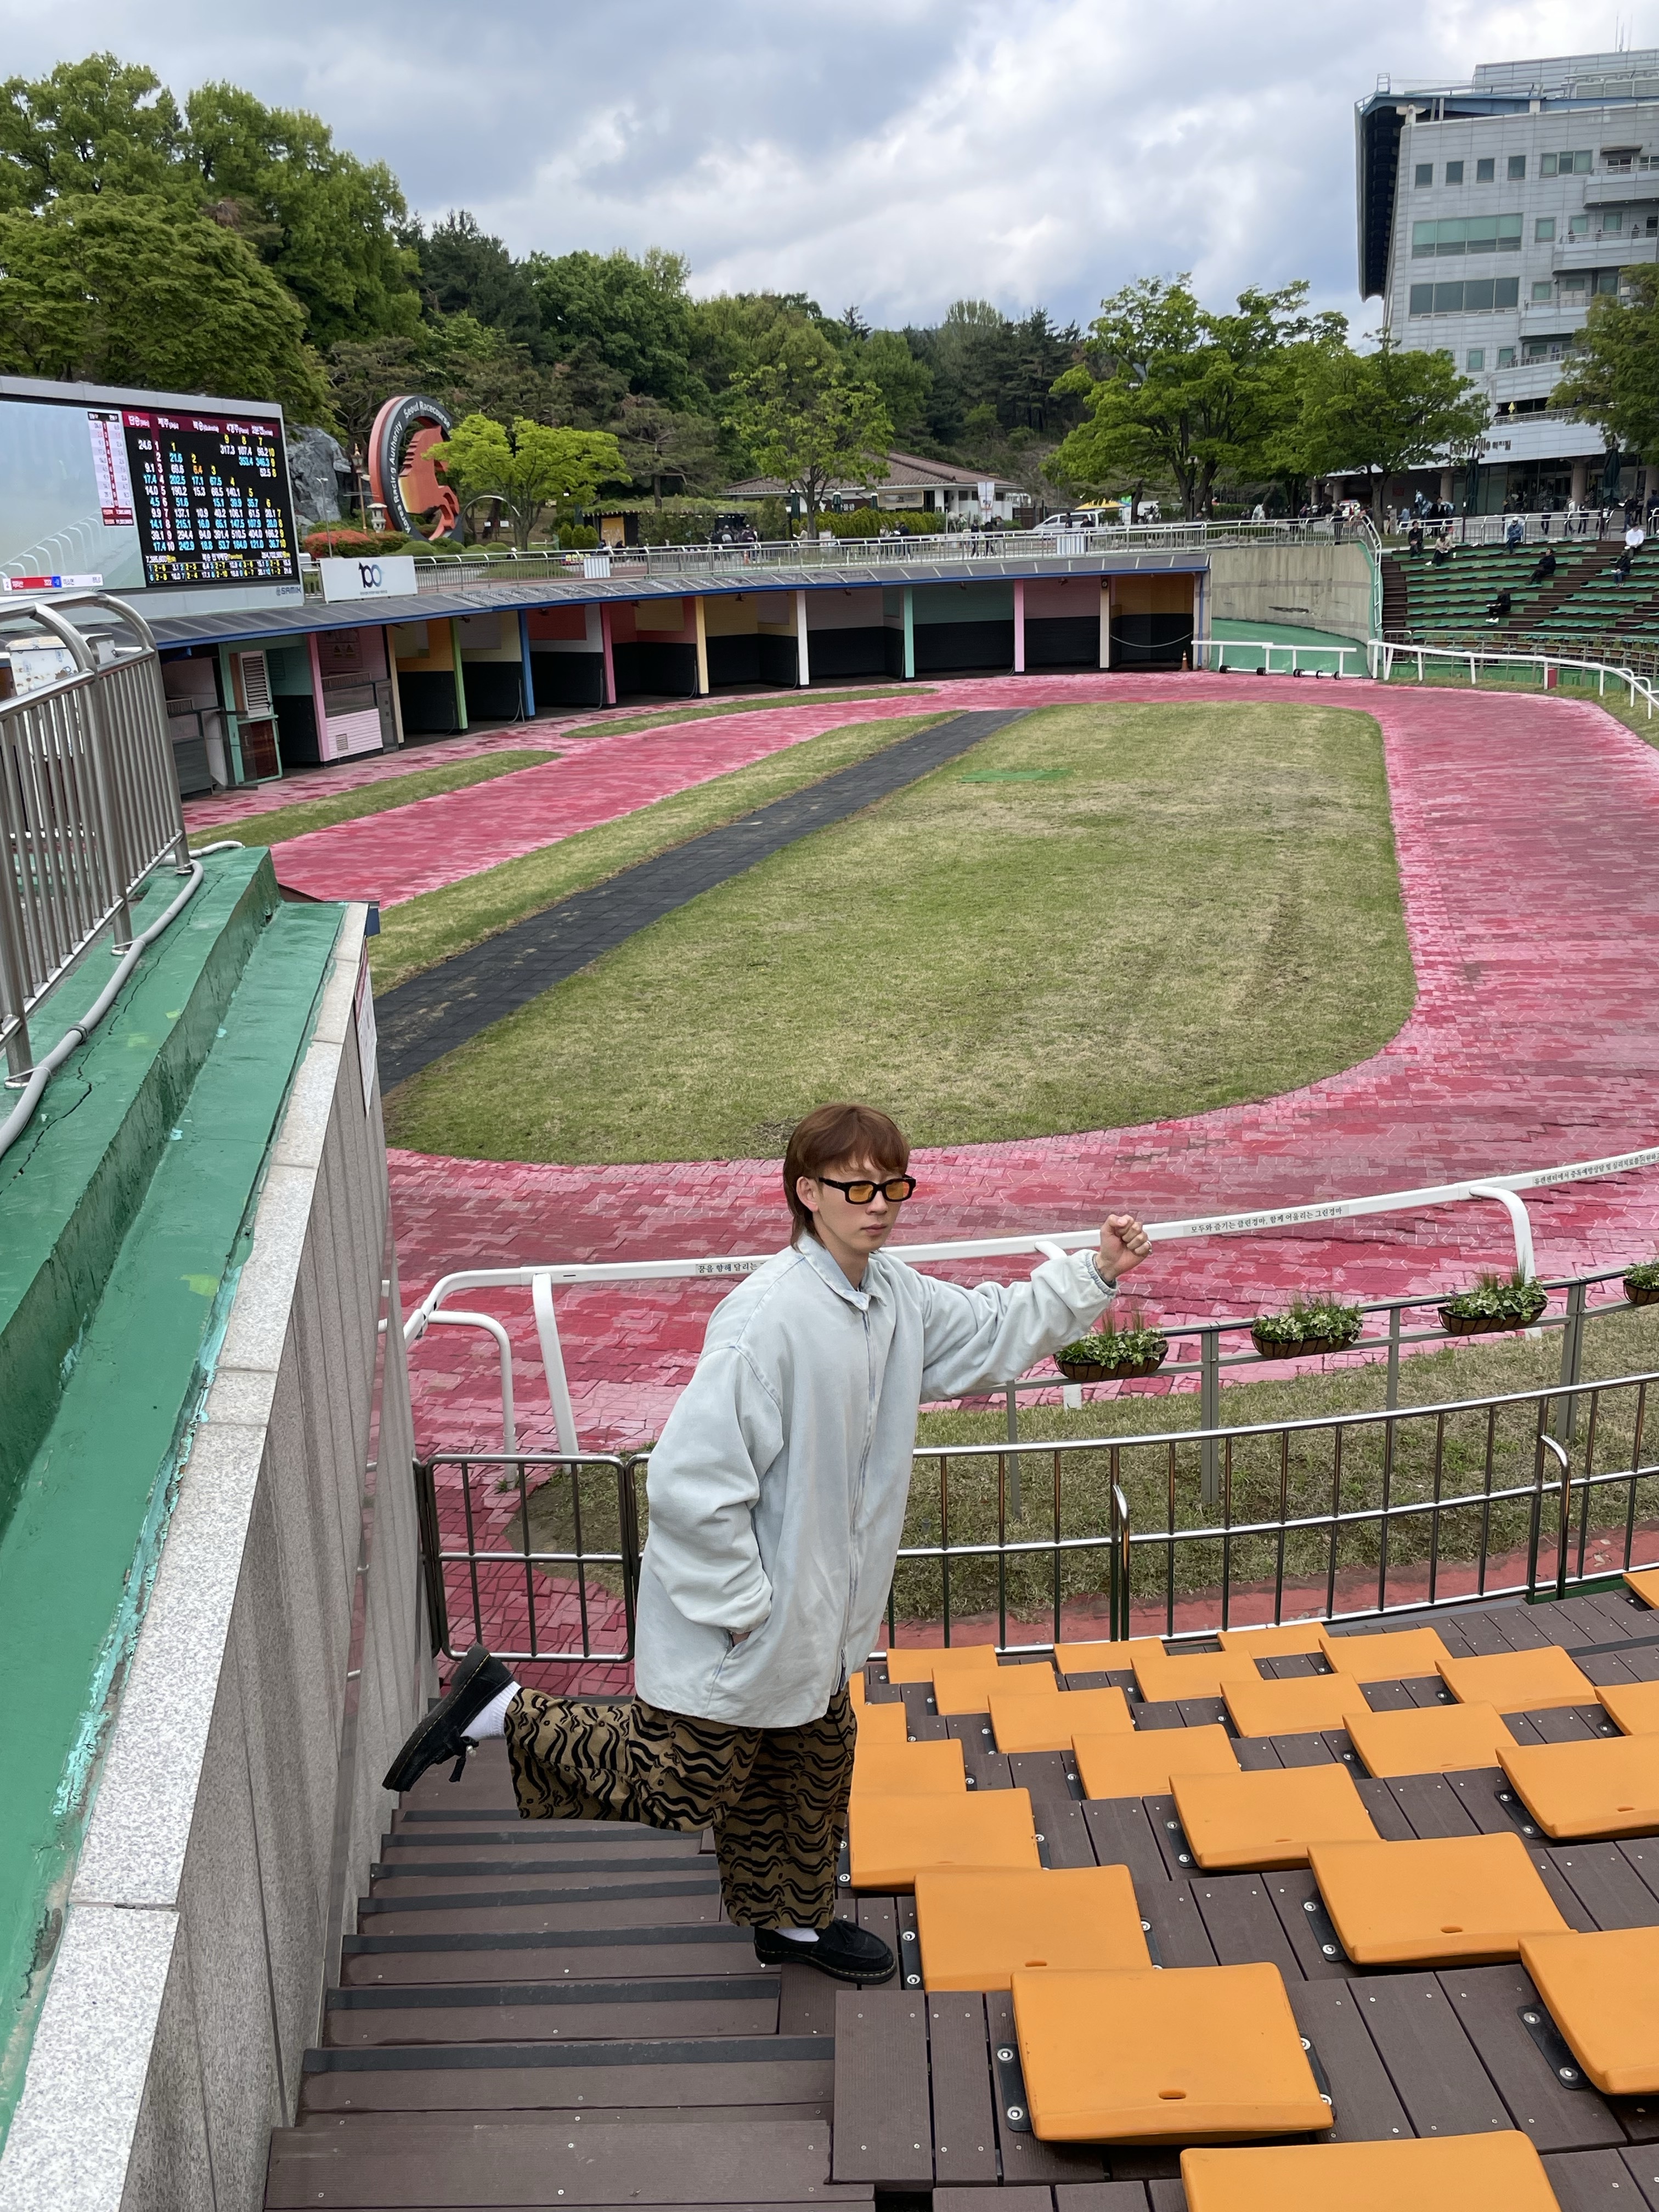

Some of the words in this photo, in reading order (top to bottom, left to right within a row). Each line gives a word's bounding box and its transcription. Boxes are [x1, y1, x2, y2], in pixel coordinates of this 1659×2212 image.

[403, 402, 419, 419] Seoul
[420, 401, 450, 428] Racecourse
[155, 441, 159, 450] 1
[171, 441, 176, 452] 1
[258, 436, 262, 446] 7
[389, 420, 403, 465] Authority
[156, 452, 161, 462] 2
[191, 453, 197, 464] 2
[157, 463, 163, 473] 3
[211, 465, 216, 475] 3
[143, 474, 157, 484] 17.4
[159, 475, 164, 484] 4
[191, 475, 204, 486] 17.1
[230, 476, 235, 486] 4
[145, 486, 158, 495] 14.0
[161, 486, 166, 495] 5
[249, 487, 253, 497] 5
[150, 496, 160, 506] 4.5
[162, 497, 167, 506] 6
[213, 498, 224, 507] 15.1
[266, 498, 271, 507] 6
[151, 508, 161, 518] 9.9
[163, 508, 168, 517] 7
[174, 508, 189, 518] 137.1
[196, 508, 208, 518] 10.9
[277, 509, 281, 517] 7
[150, 519, 162, 529] 14.1
[398, 505, 411, 535] Korea
[167, 530, 172, 540] 9
[153, 541, 166, 551] 17.4
[167, 541, 175, 551] 10
[1191, 1224, 1212, 1233] 모두와
[1214, 1221, 1235, 1231] 즐기는
[1237, 1217, 1268, 1227] 클린경마,
[1270, 1215, 1284, 1224] 함께
[1285, 1211, 1313, 1221] 어울리는
[1315, 1207, 1342, 1217] 그린경마
[698, 1265, 713, 1273] 꿈을
[716, 1263, 731, 1272] 향해
[733, 1262, 758, 1271] 달리는
